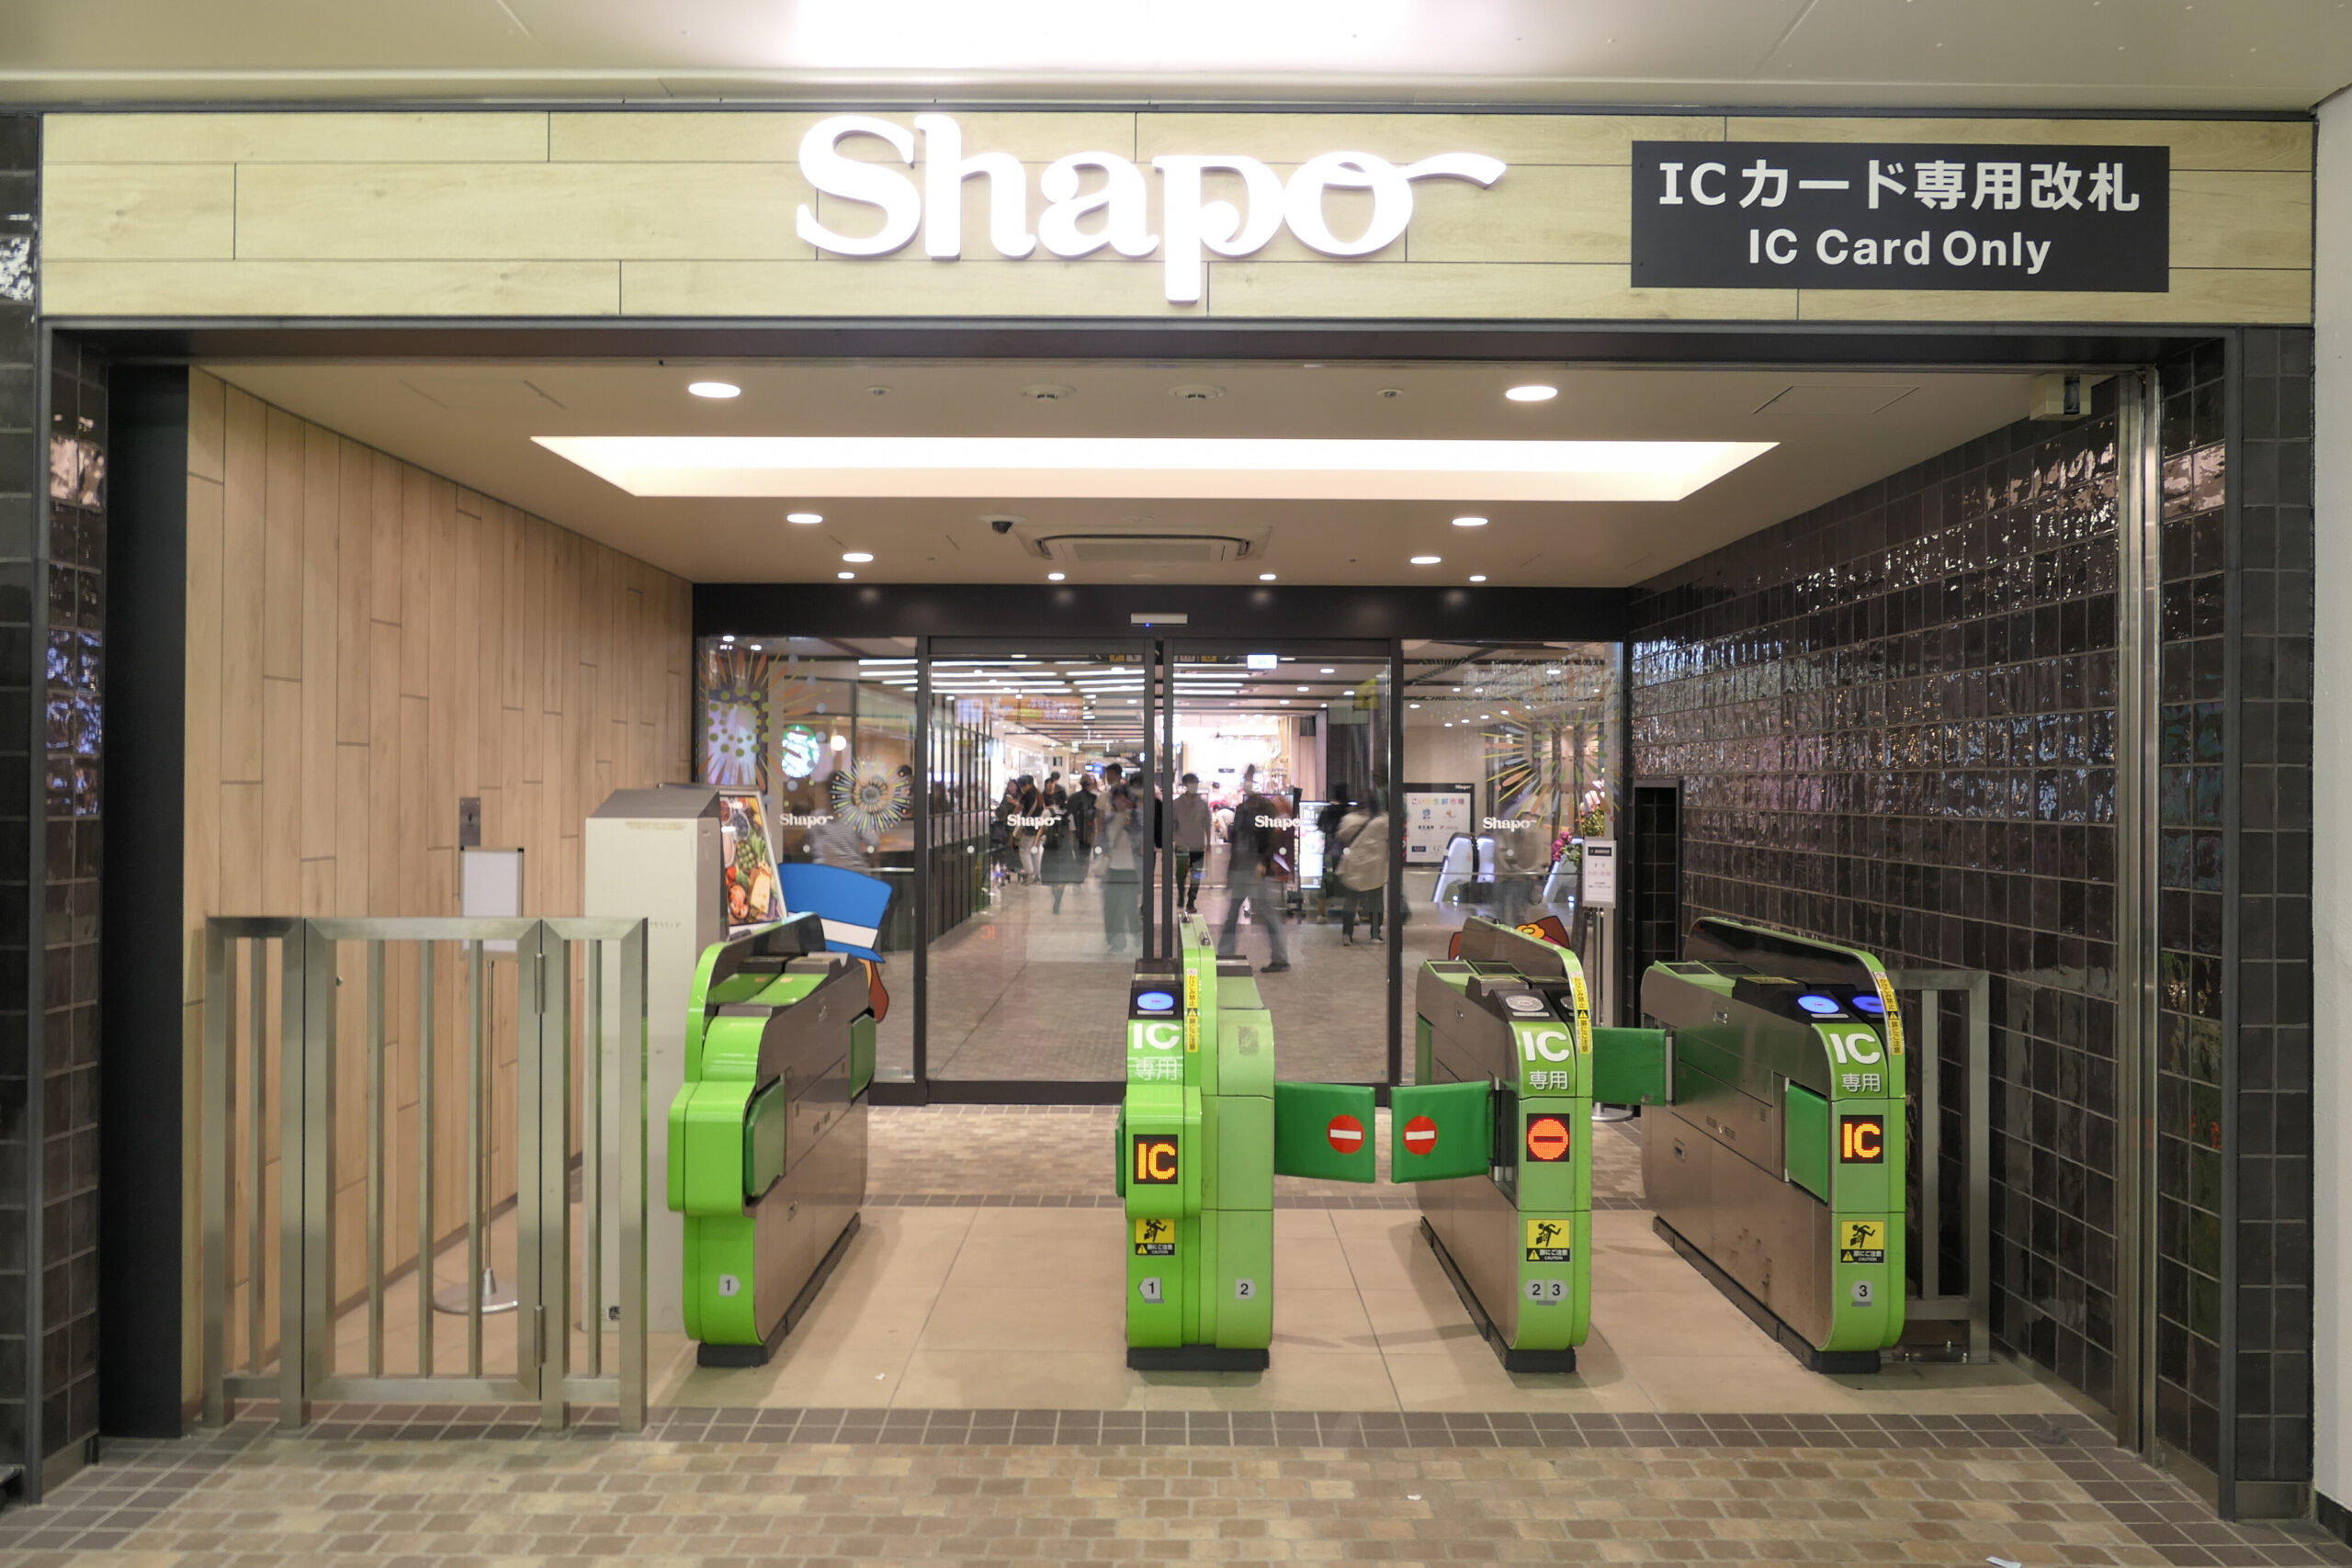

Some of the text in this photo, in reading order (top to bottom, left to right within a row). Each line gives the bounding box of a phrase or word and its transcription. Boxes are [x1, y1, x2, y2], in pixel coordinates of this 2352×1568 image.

[1658, 160, 2140, 212] ICカード専用改札
[796, 113, 1507, 303] Shapo
[1749, 228, 2052, 275] IC Card Only
[779, 813, 833, 829] Shapo
[1007, 813, 1061, 829] Shapo
[1254, 815, 1303, 830] Shapo
[1482, 816, 1536, 832] Shapo
[1133, 1022, 1180, 1050] IC
[1521, 1031, 1569, 1062] IC
[1829, 1032, 1881, 1065] IC
[1135, 1057, 1178, 1081] 専用
[1529, 1070, 1568, 1090] 専用
[1841, 1073, 1881, 1092] 専用
[1842, 1122, 1881, 1158] IC
[1137, 1143, 1176, 1180] IC
[725, 1279, 731, 1291] 1
[1148, 1282, 1155, 1293] 1
[1240, 1283, 1249, 1295] 2
[1532, 1284, 1560, 1296] 2 3
[1859, 1285, 1868, 1298] 3
